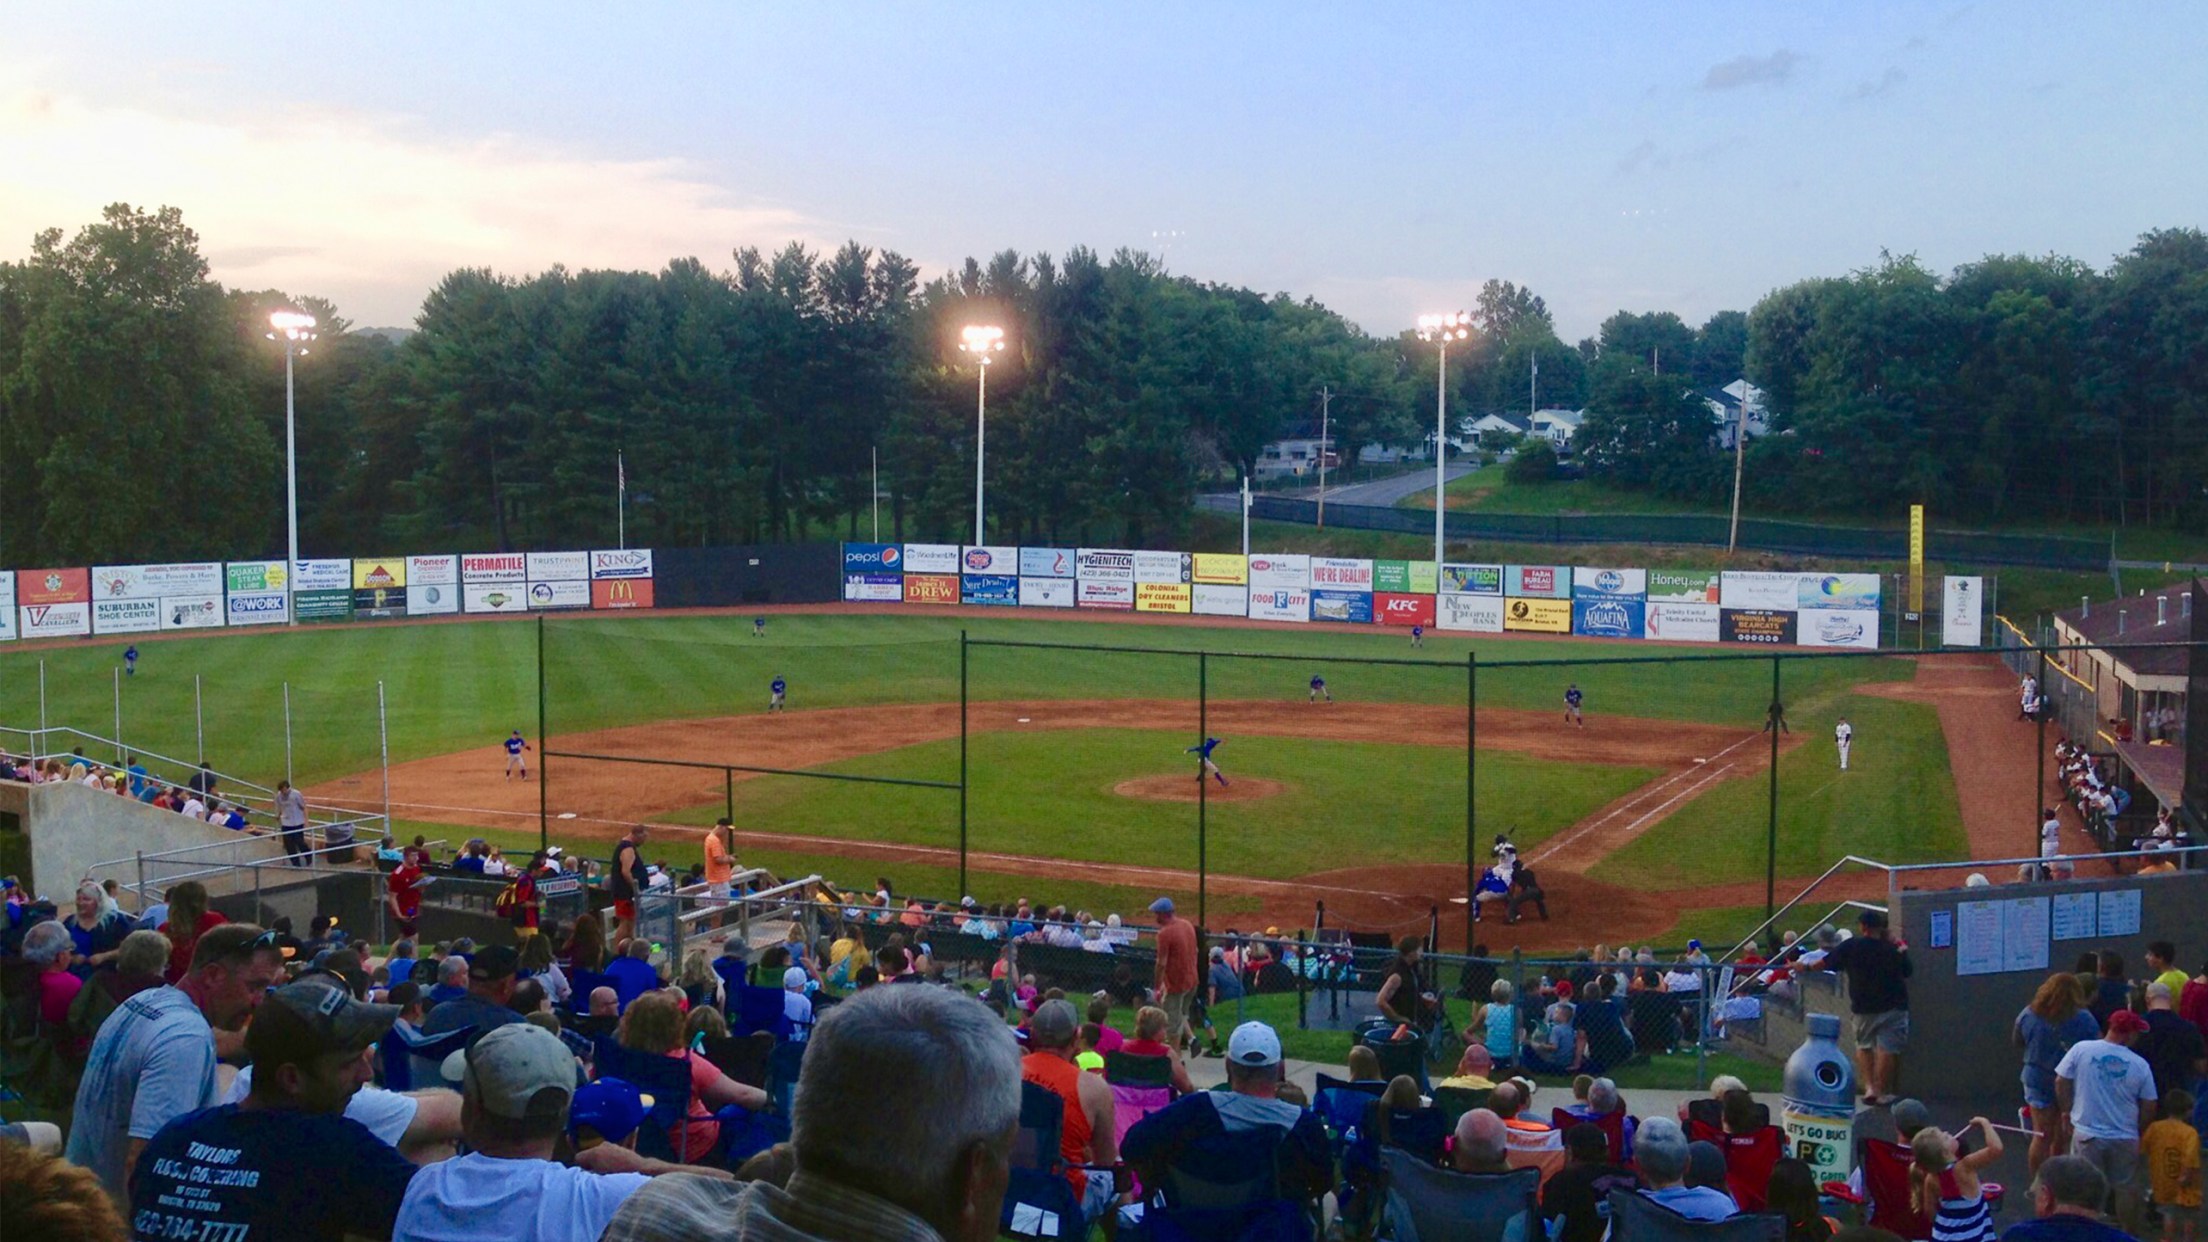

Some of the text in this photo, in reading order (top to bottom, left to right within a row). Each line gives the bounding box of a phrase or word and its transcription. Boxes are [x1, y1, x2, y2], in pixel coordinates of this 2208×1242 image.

[414, 558, 450, 566] Pioneer
[596, 553, 634, 568] KING
[846, 552, 880, 564] pepsi
[1077, 555, 1132, 566] HYGIENITECH
[464, 558, 523, 571] PERMATILE
[1325, 560, 1358, 568] Friendship
[230, 566, 265, 577] QUAKER
[464, 572, 493, 580] Concrete
[495, 571, 524, 579] Products
[1080, 569, 1096, 577] (423)
[1313, 567, 1337, 582] WE'RE
[1339, 567, 1370, 583] DEALIN!
[237, 575, 261, 583] STEAK
[1651, 573, 1705, 588] Honey.com
[909, 586, 953, 598] DREW
[1106, 585, 1127, 593] Ridge
[232, 597, 283, 612] @WORK
[1252, 594, 1273, 604] FOOD
[1288, 596, 1306, 605] CITY
[98, 602, 155, 614] SUBURBAN
[1386, 599, 1419, 612] KFC
[98, 610, 155, 621] SHOE CENTER
[1666, 609, 1706, 617] Trinity United
[1583, 609, 1630, 629] AQUAFINA
[1666, 616, 1717, 625] Methodist Church
[1731, 615, 1788, 623] VIRGINIA HIGH
[1738, 622, 1779, 630] BEARCATS
[551, 881, 576, 891] RESERVED
[1787, 1122, 1847, 1141] LET'S GO BUCS
[187, 1141, 242, 1165] TAYLORS
[1801, 1143, 1812, 1159] P
[2163, 1147, 2182, 1179] 6
[152, 1158, 189, 1181] FLOO
[1821, 1172, 1847, 1181] GREEN
[186, 1199, 196, 1209] TN
